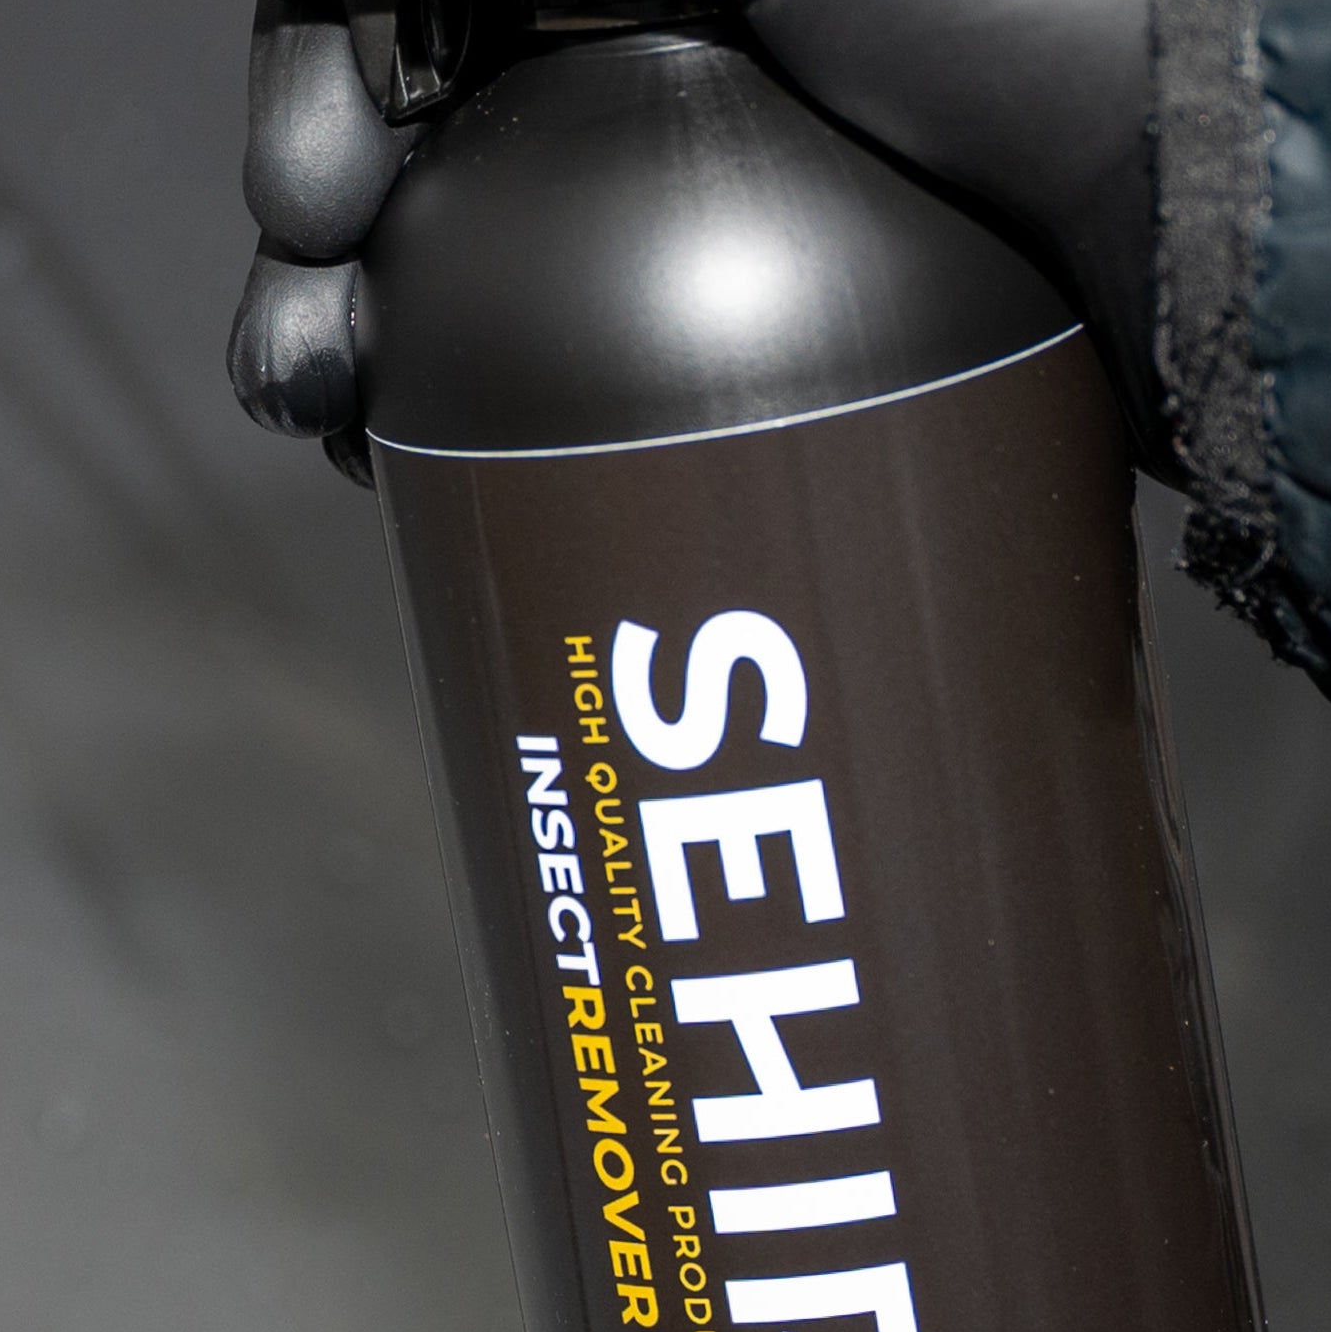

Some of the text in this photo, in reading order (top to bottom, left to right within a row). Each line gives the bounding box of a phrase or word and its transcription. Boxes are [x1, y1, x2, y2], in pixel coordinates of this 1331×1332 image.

[564, 635, 610, 745] HIGH
[584, 761, 645, 950] QUALITY
[625, 964, 689, 1187] CLEANING
